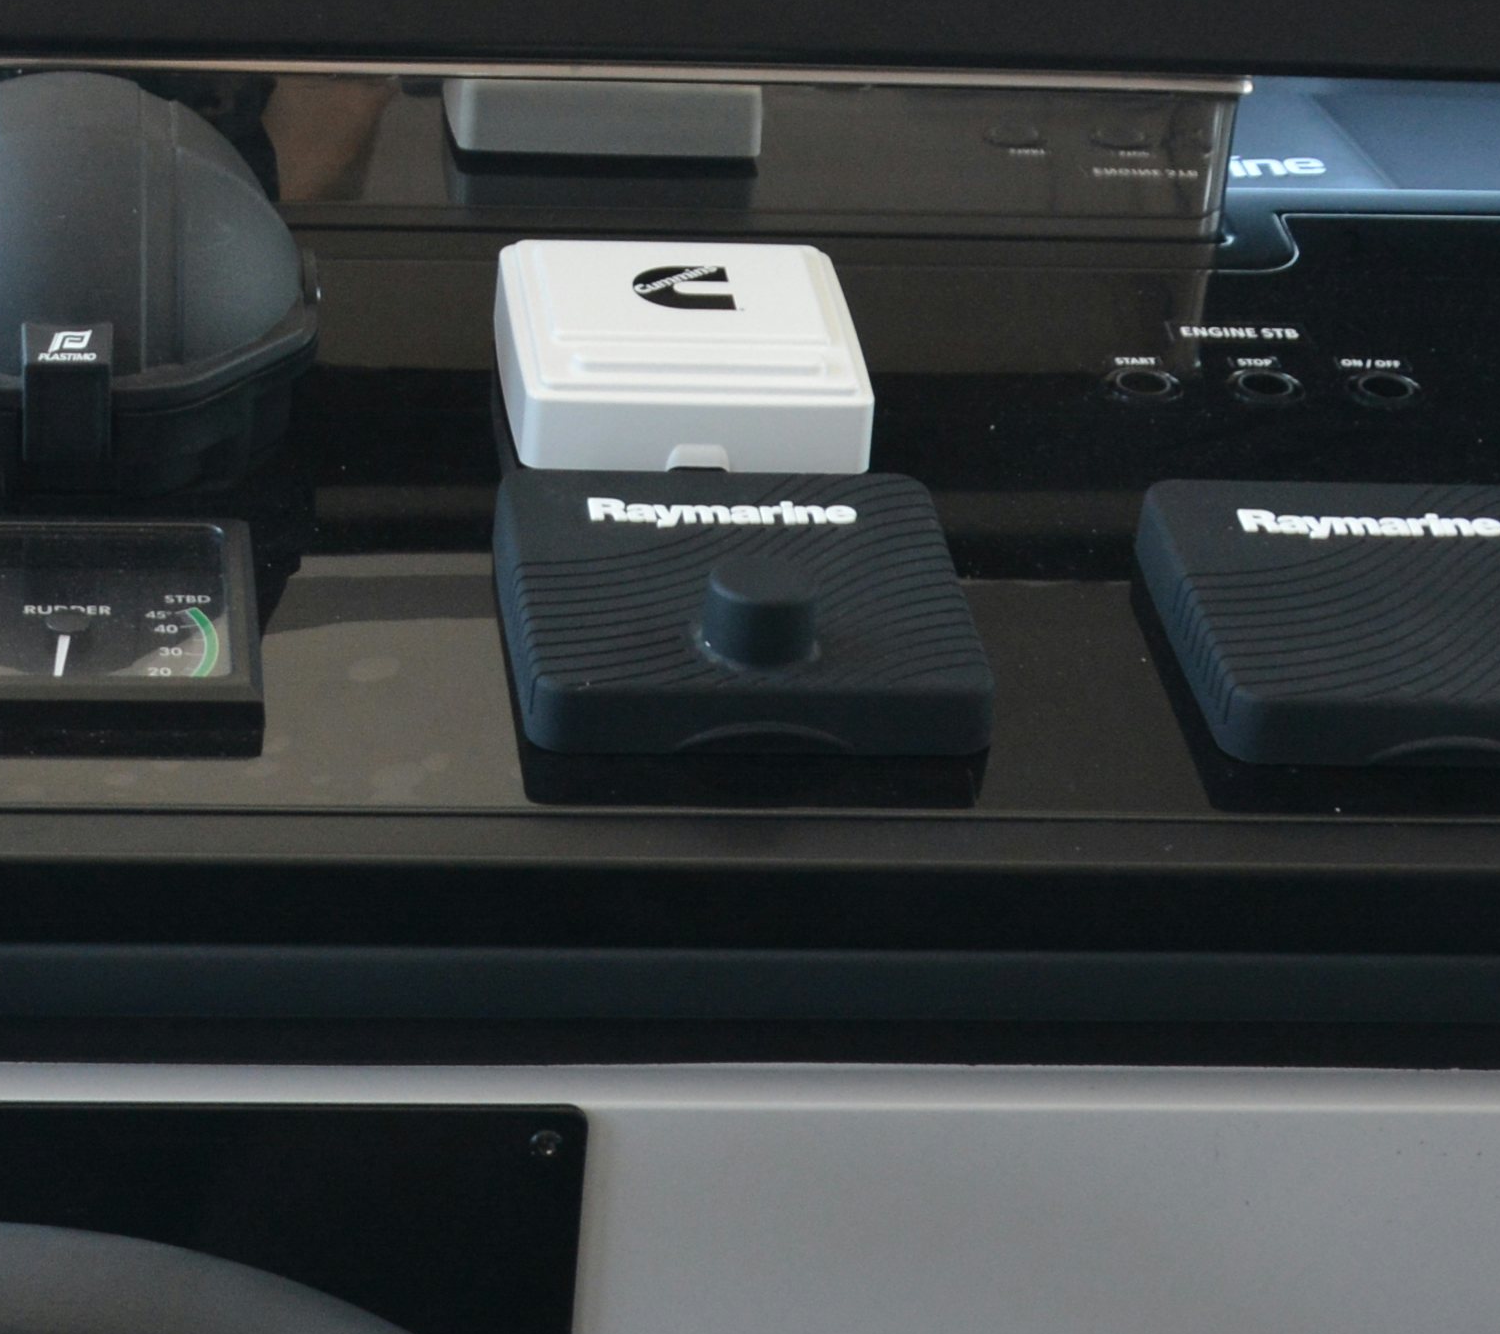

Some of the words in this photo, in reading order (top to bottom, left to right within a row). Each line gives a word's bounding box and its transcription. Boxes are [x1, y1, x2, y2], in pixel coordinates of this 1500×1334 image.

[633, 264, 718, 295] Cummins
[1180, 325, 1258, 338] ENGINE
[1261, 327, 1300, 340] STB
[38, 352, 97, 362] PLASTIMO
[1114, 357, 1156, 366] START
[1237, 358, 1273, 367] STOP
[1340, 358, 1363, 368] ON
[1375, 359, 1401, 368] OFF
[586, 493, 858, 530] Raymarine
[164, 594, 212, 605] STBD
[154, 624, 179, 634] 40
[159, 647, 183, 656] 30
[148, 666, 172, 676] 20
